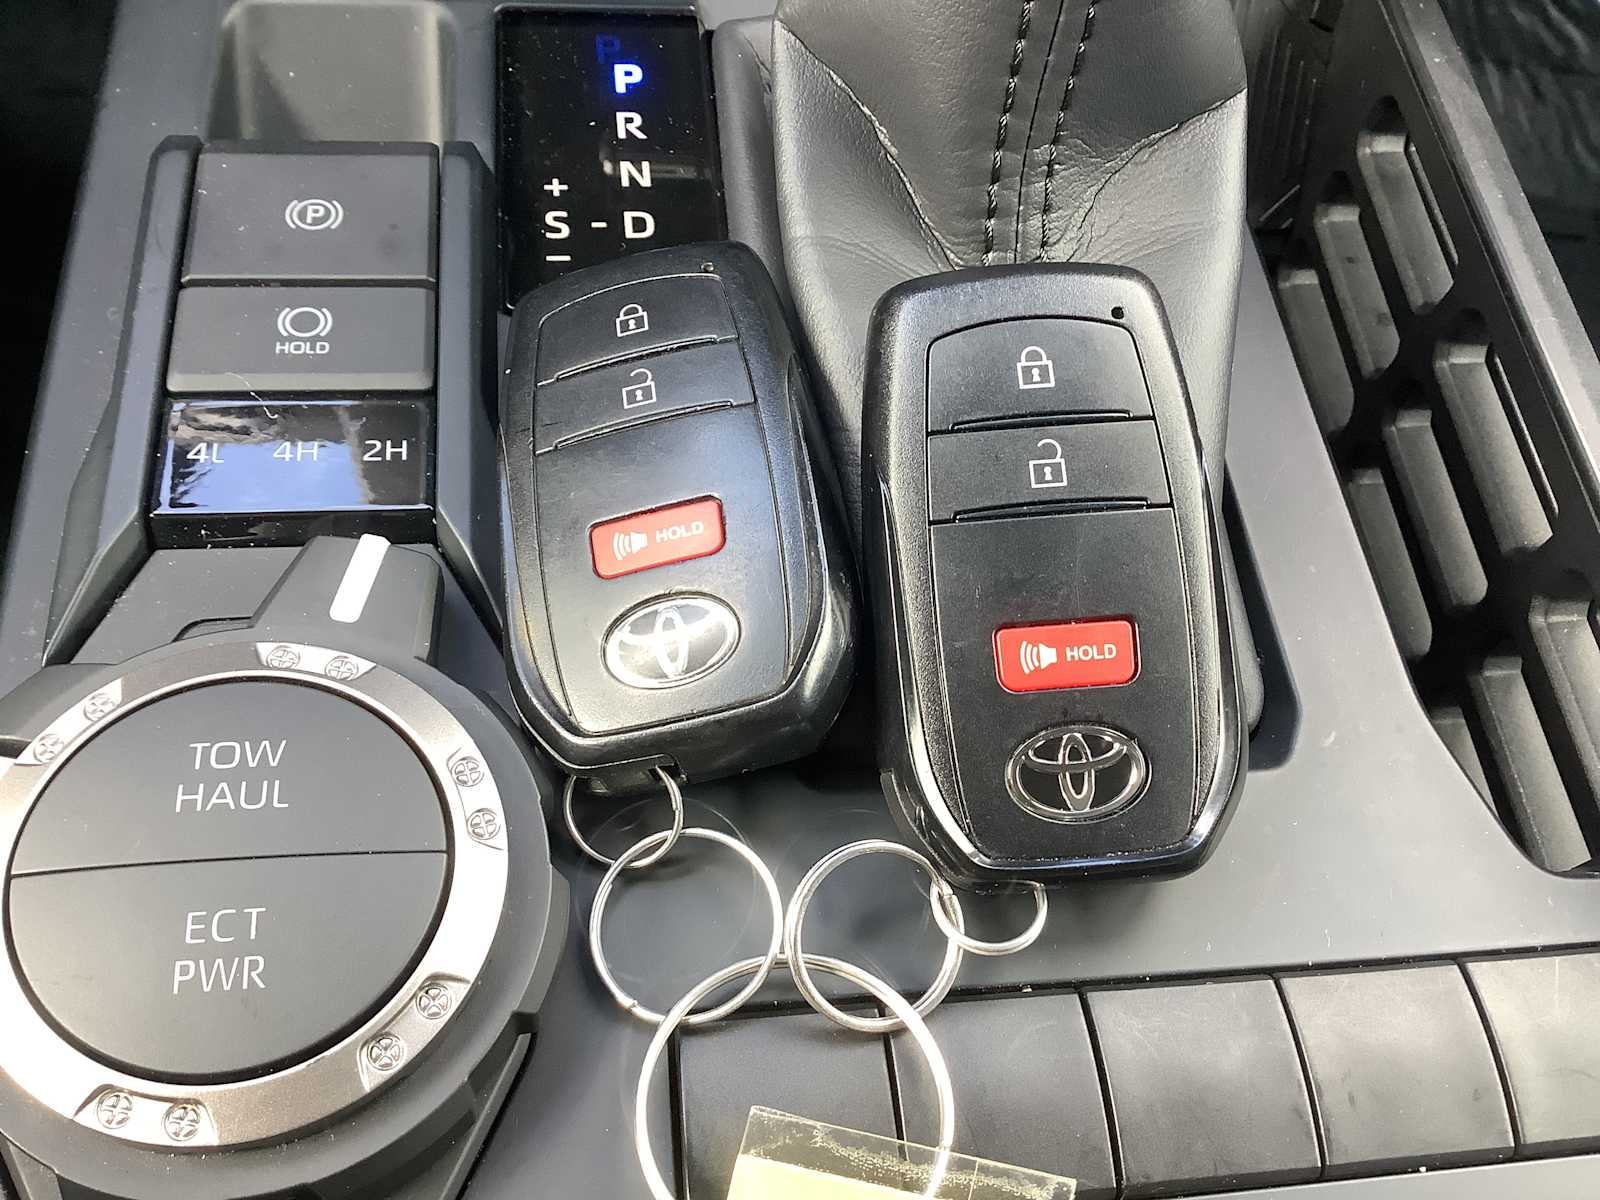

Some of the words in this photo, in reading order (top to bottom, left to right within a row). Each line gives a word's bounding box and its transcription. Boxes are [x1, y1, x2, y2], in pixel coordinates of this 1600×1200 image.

[614, 64, 643, 94] P
[616, 111, 648, 139] R
[619, 161, 652, 187] N
[305, 205, 324, 224] P
[544, 211, 571, 239] S
[623, 211, 655, 239] D
[275, 341, 330, 355] HOLD
[186, 442, 225, 463] 4L
[273, 441, 318, 462] 4H
[362, 440, 408, 461] 2H
[655, 521, 704, 543] HOLD
[1065, 644, 1116, 662] HOLD
[190, 740, 287, 771] TOW
[175, 779, 289, 813] HAUL
[185, 907, 266, 944] ECT
[172, 955, 266, 994] PWR
